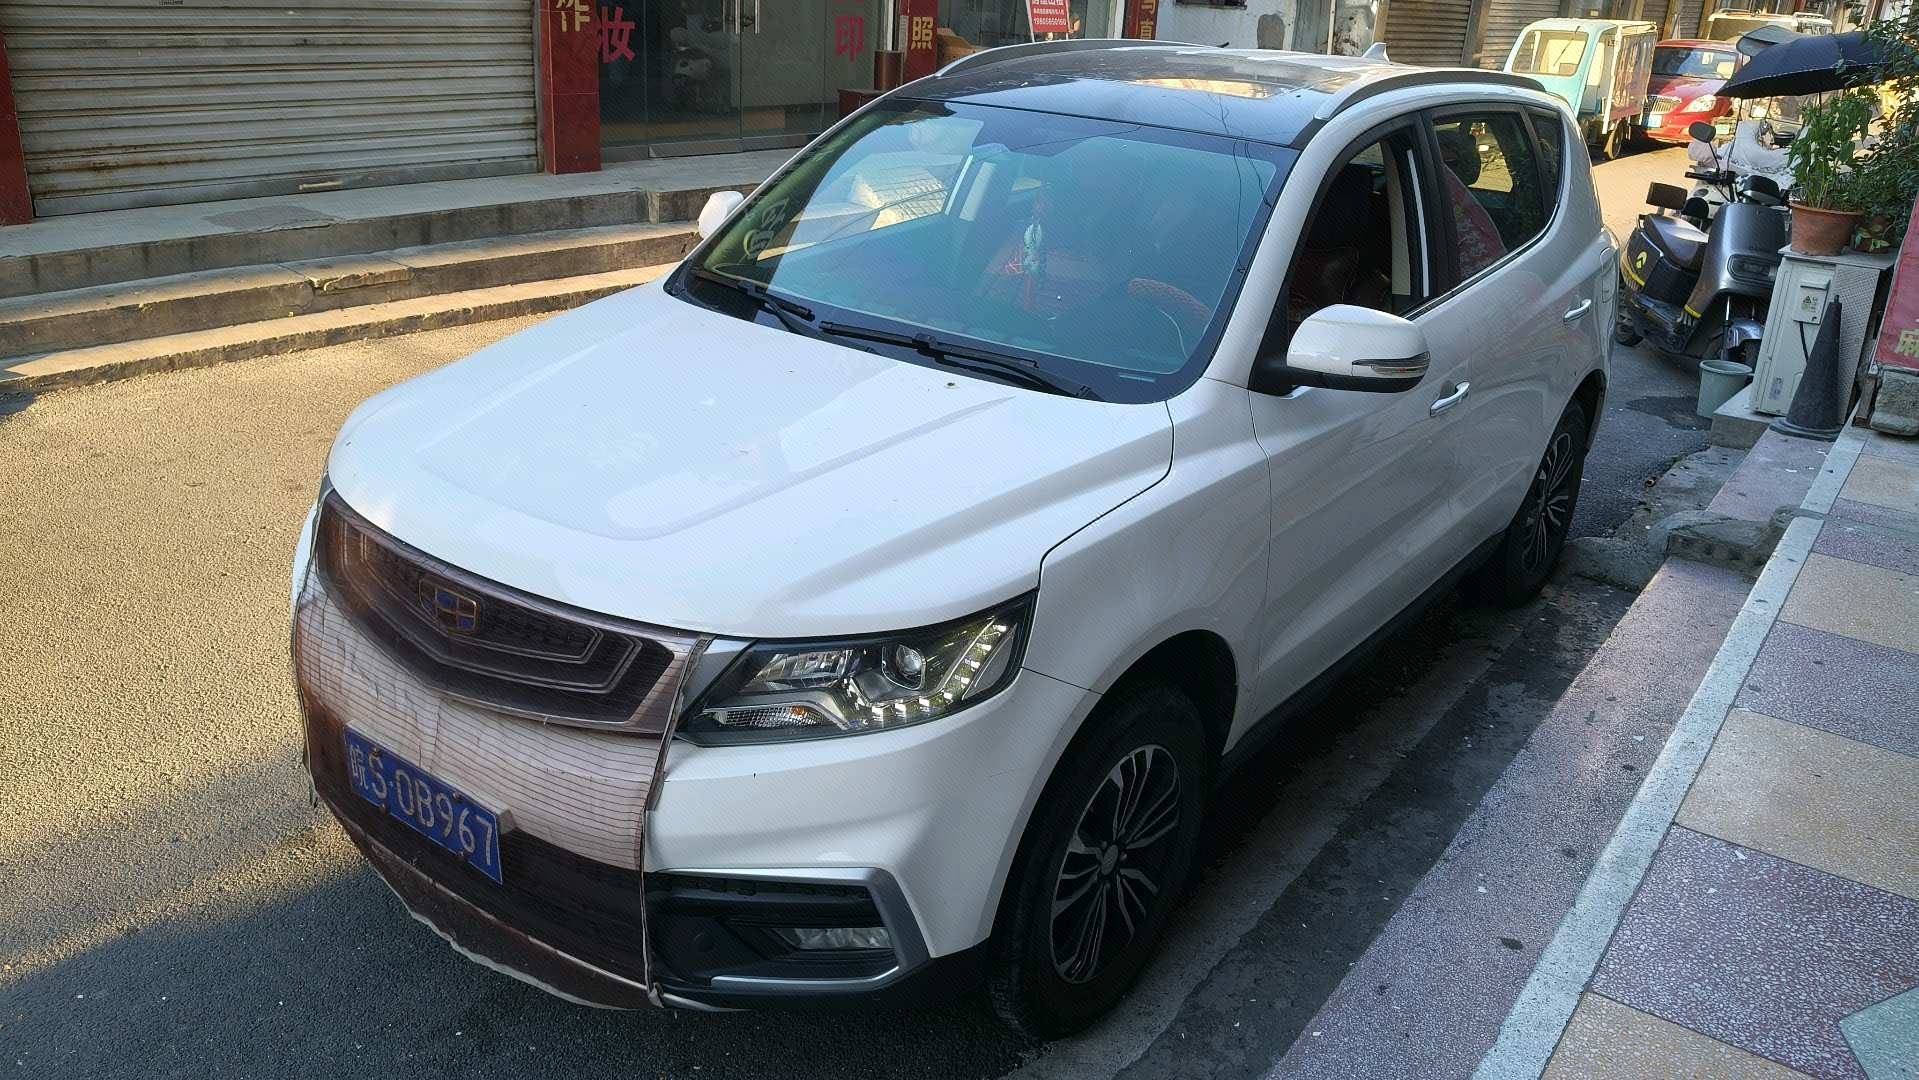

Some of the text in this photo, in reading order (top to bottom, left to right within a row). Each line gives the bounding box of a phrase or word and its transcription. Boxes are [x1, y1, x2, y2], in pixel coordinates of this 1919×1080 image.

[597, 6, 636, 64] 妆
[835, 15, 865, 63] 印
[911, 16, 934, 50] 照
